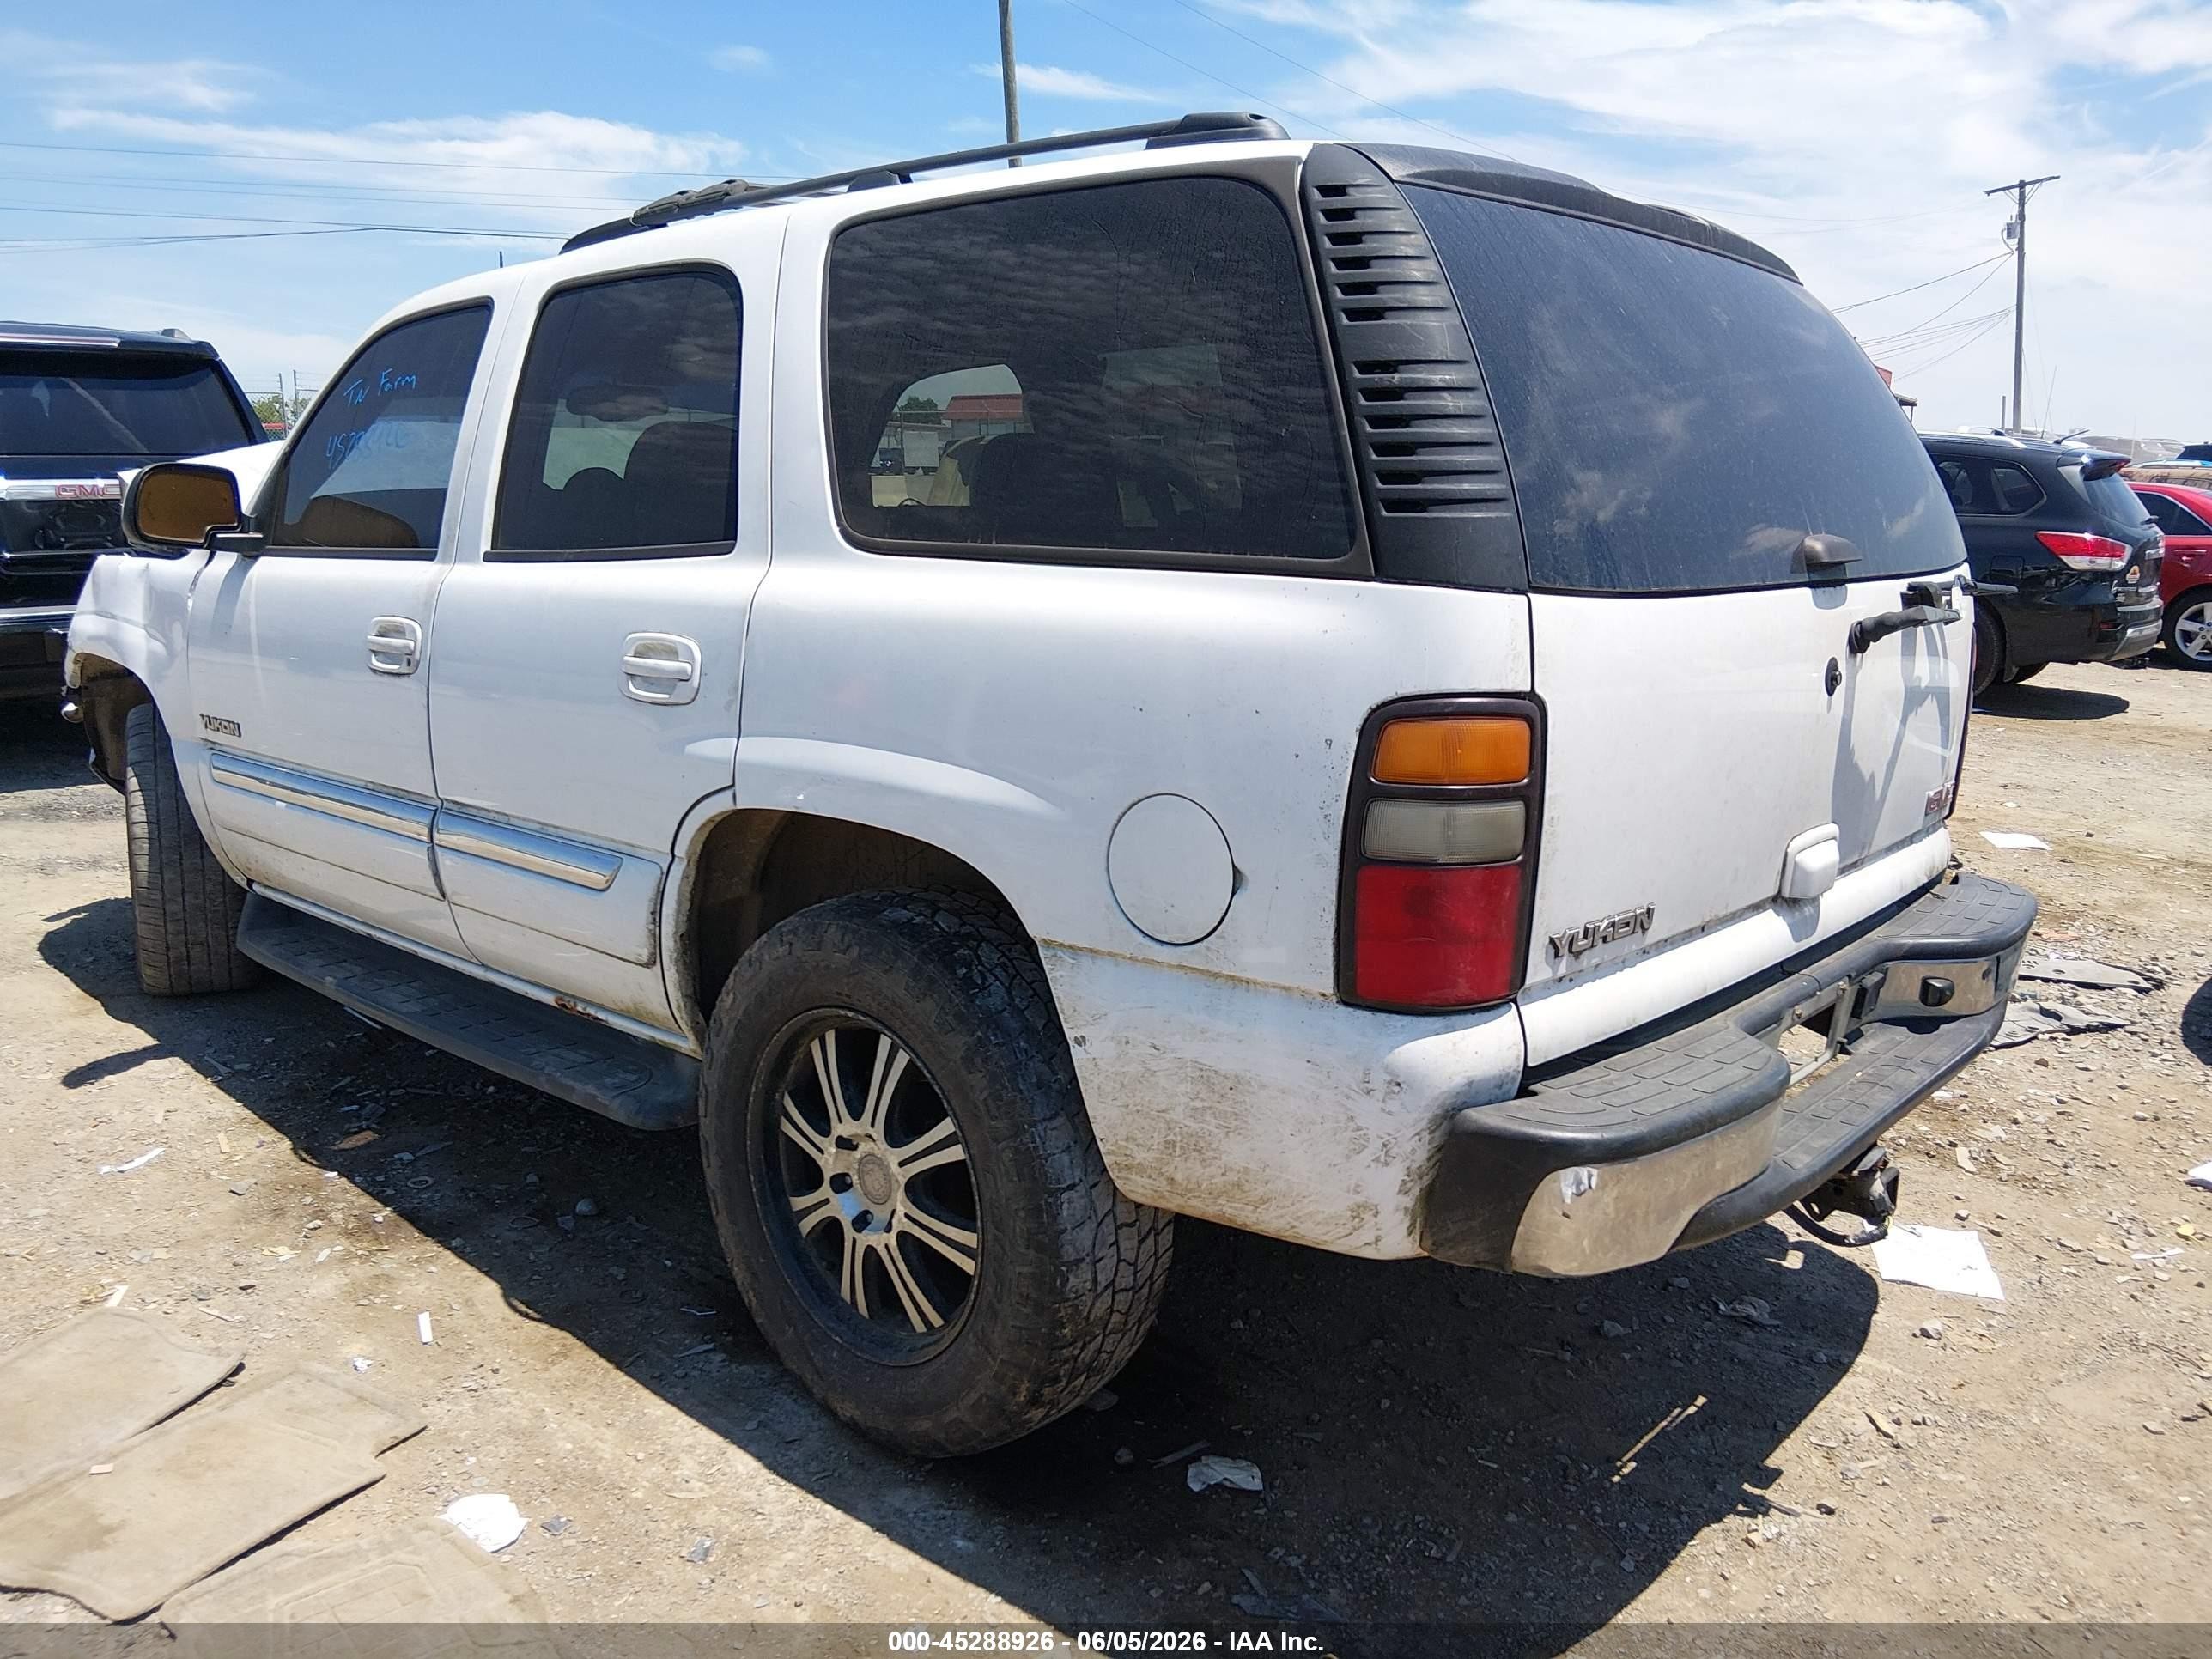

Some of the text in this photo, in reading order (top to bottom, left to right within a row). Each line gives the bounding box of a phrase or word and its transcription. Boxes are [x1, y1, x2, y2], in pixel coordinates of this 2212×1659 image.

[55, 484, 121, 499] GMC
[199, 713, 241, 738] YUKON
[1548, 902, 1656, 960] YUKON
